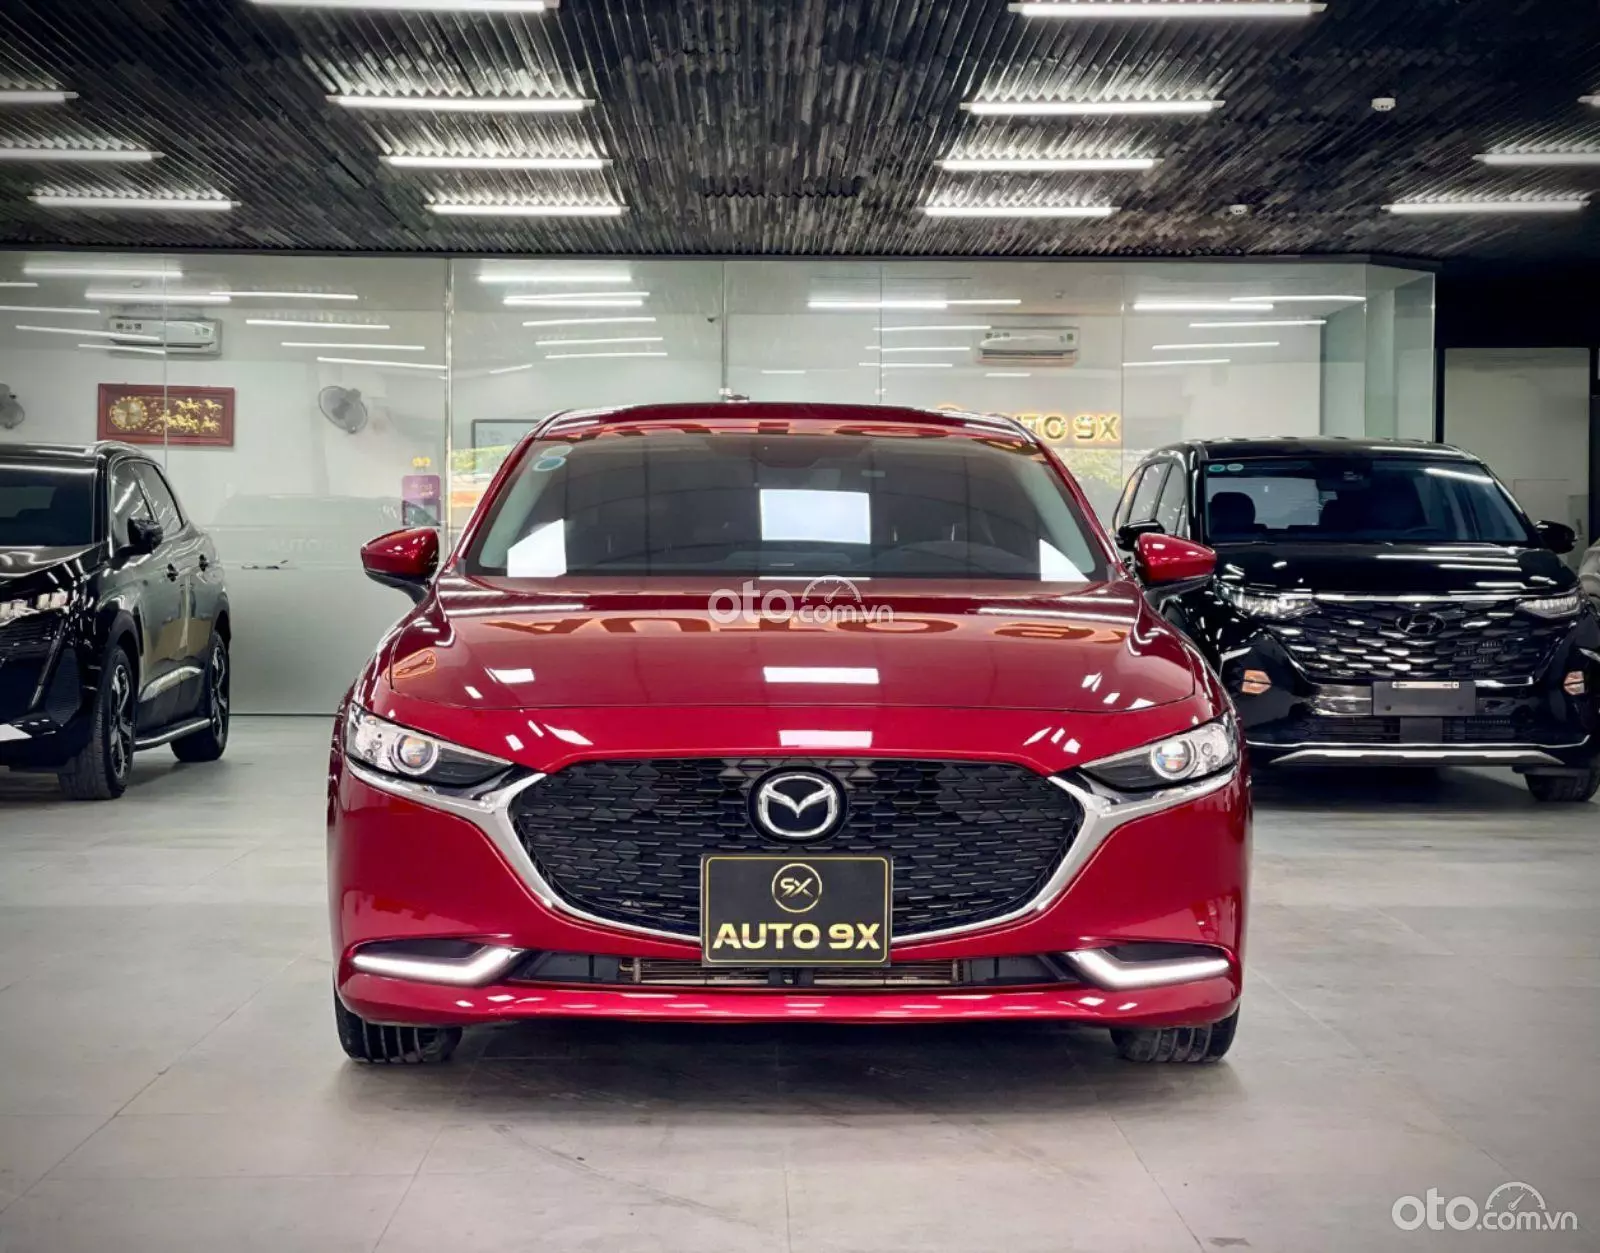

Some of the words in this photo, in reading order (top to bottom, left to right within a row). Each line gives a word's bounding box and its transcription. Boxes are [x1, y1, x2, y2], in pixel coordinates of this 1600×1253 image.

[1075, 414, 1119, 440] 9X
[712, 923, 821, 950] AUTO
[828, 923, 881, 950] 9X
